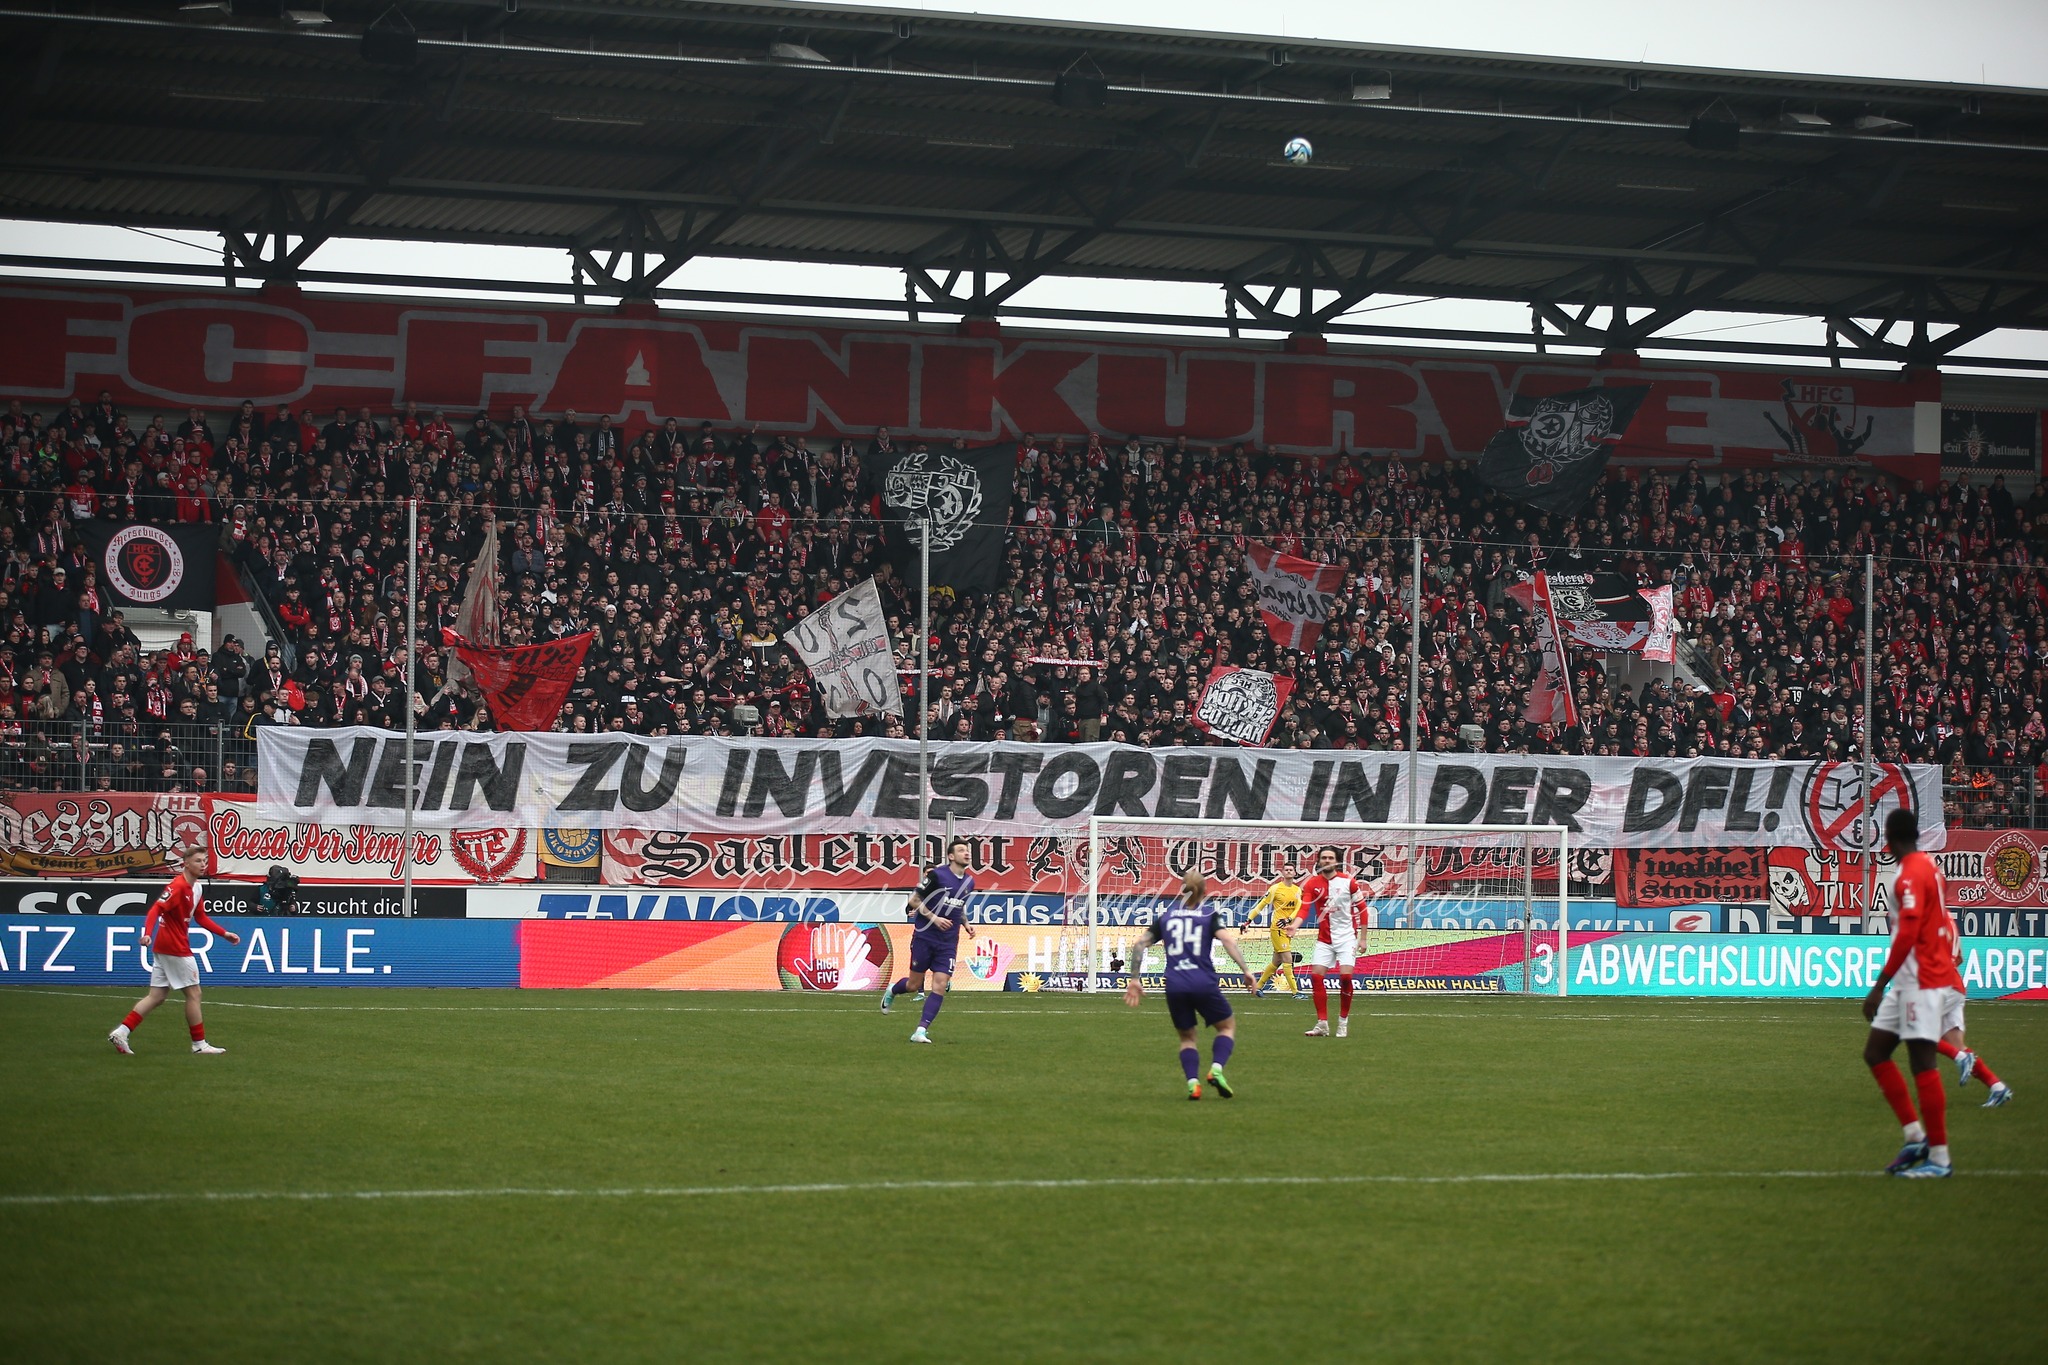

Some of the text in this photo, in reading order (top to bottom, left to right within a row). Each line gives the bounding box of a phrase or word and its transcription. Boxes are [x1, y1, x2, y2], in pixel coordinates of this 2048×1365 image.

[1801, 386, 1843, 401] HFC
[113, 527, 173, 549] Merseburger
[129, 588, 161, 600] Jungs
[1792, 690, 1802, 703] 19
[294, 737, 1795, 833] NEIN ZU INVESTOREN IN DER DFL!
[291, 823, 343, 863] Per
[345, 824, 441, 878] Sempre
[1988, 834, 2036, 858] HALLESCHER
[1985, 866, 2034, 899] FUSSBALLCLUB
[1958, 884, 1986, 902] seit
[316, 898, 367, 914] sucht
[1166, 917, 1203, 957] 34
[0, 926, 76, 972] TZ
[241, 928, 392, 975] ALLE.
[816, 957, 839, 970] HIGH
[817, 970, 839, 984] FIVE
[1366, 979, 1447, 991] SPIELBANK
[1451, 980, 1498, 991] HALLE
